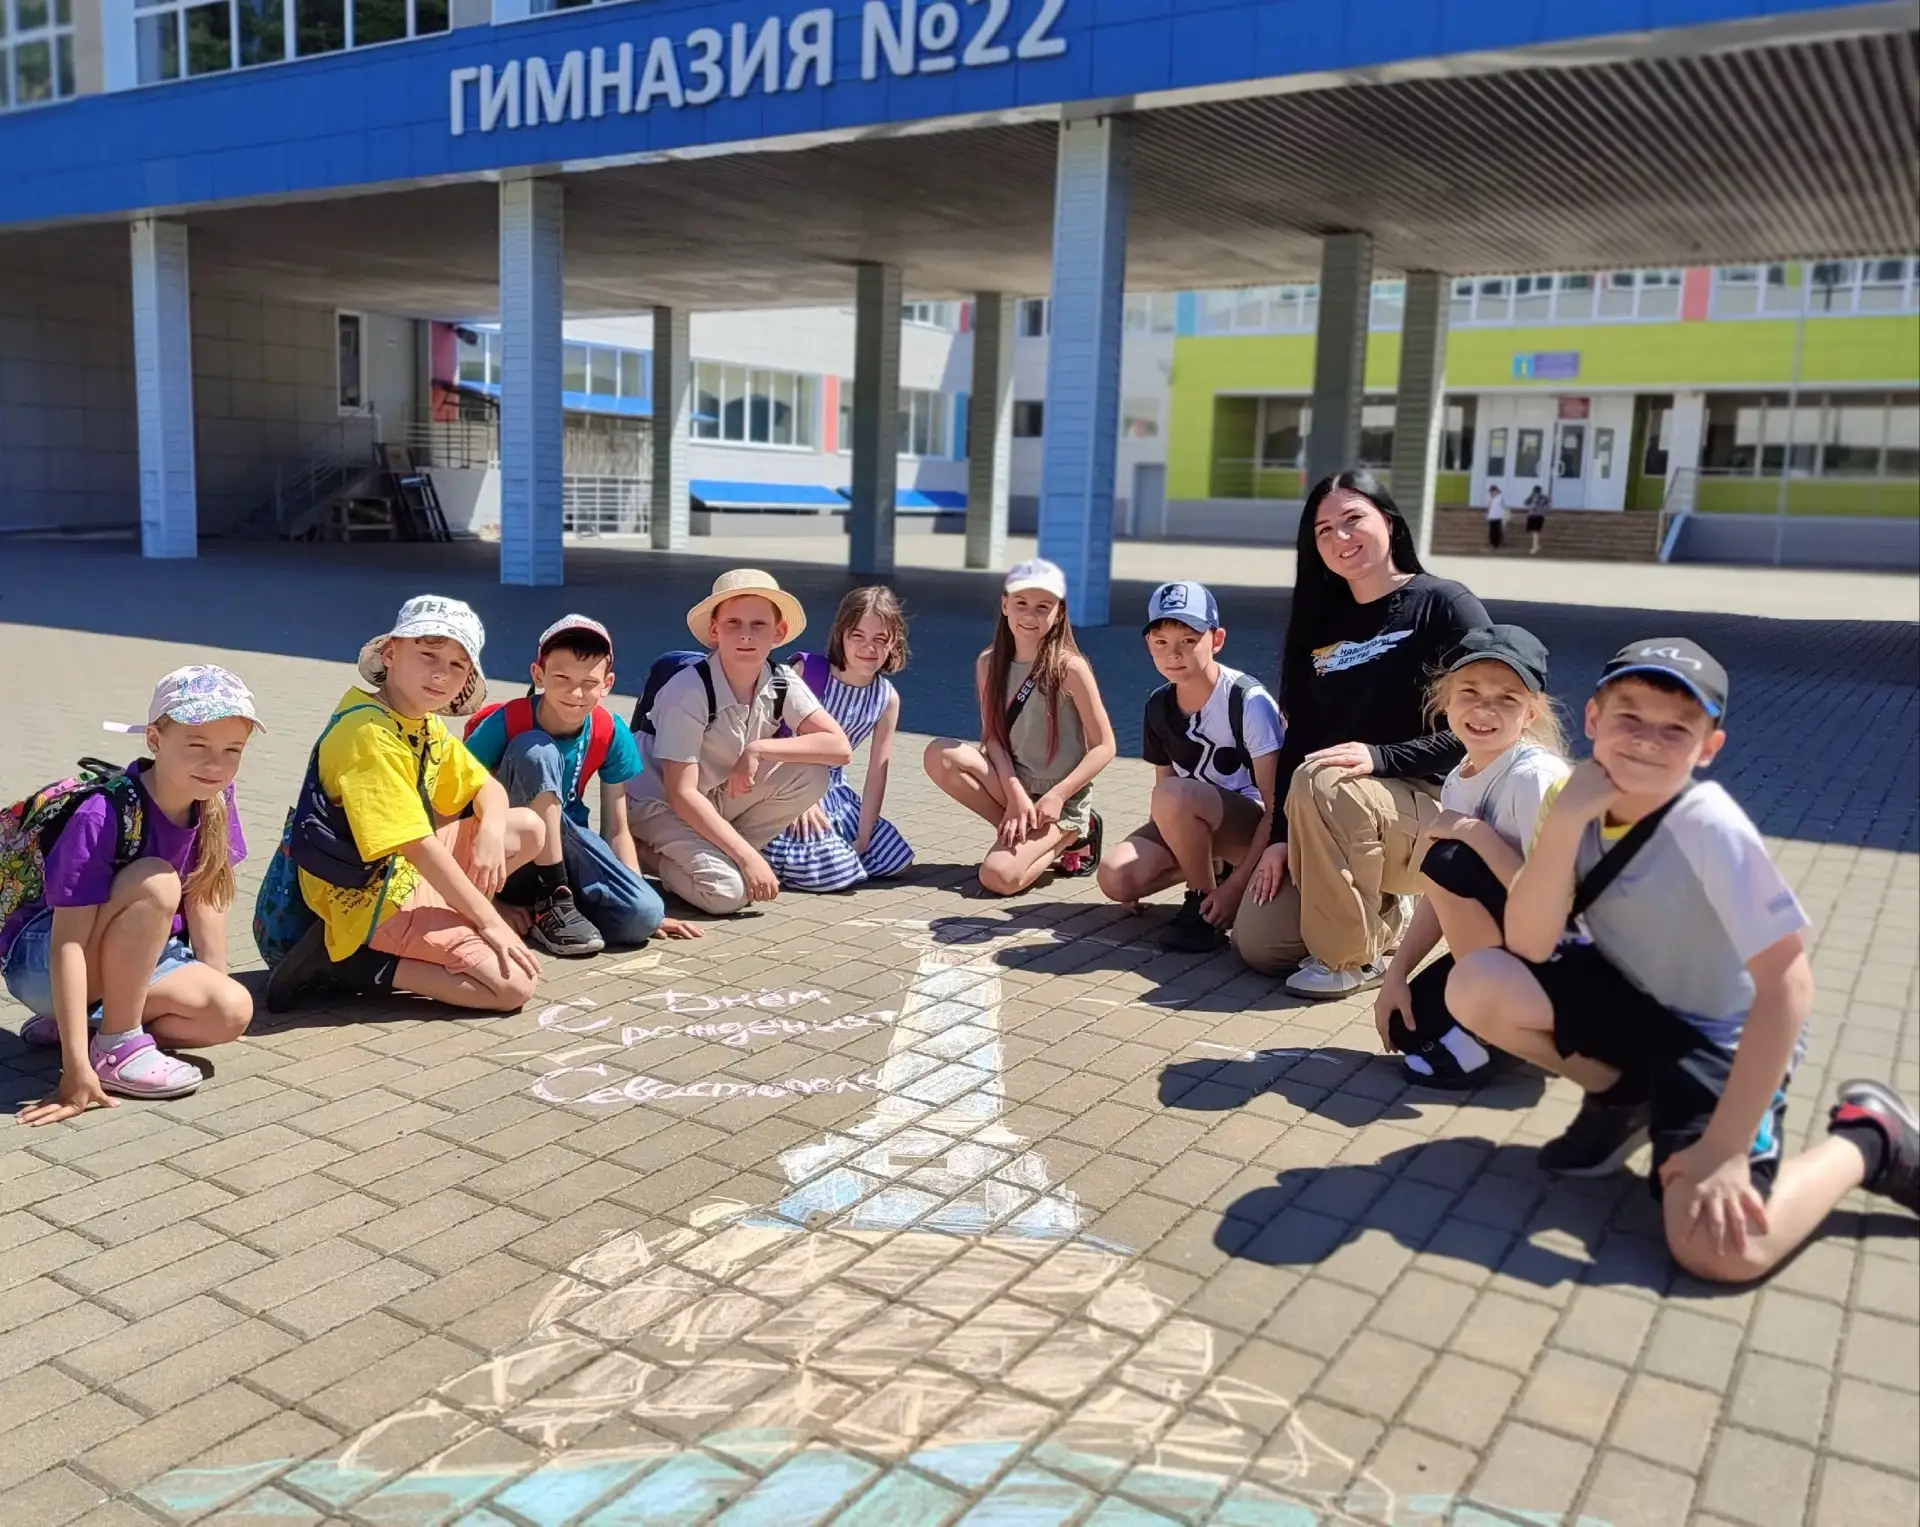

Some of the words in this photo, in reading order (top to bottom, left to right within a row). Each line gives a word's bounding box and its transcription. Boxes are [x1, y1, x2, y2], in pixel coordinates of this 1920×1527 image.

[450, 8, 832, 136] ГИМНАЗИЯ
[860, 0, 1067, 80] №22
[1016, 679, 1035, 703] SEE
